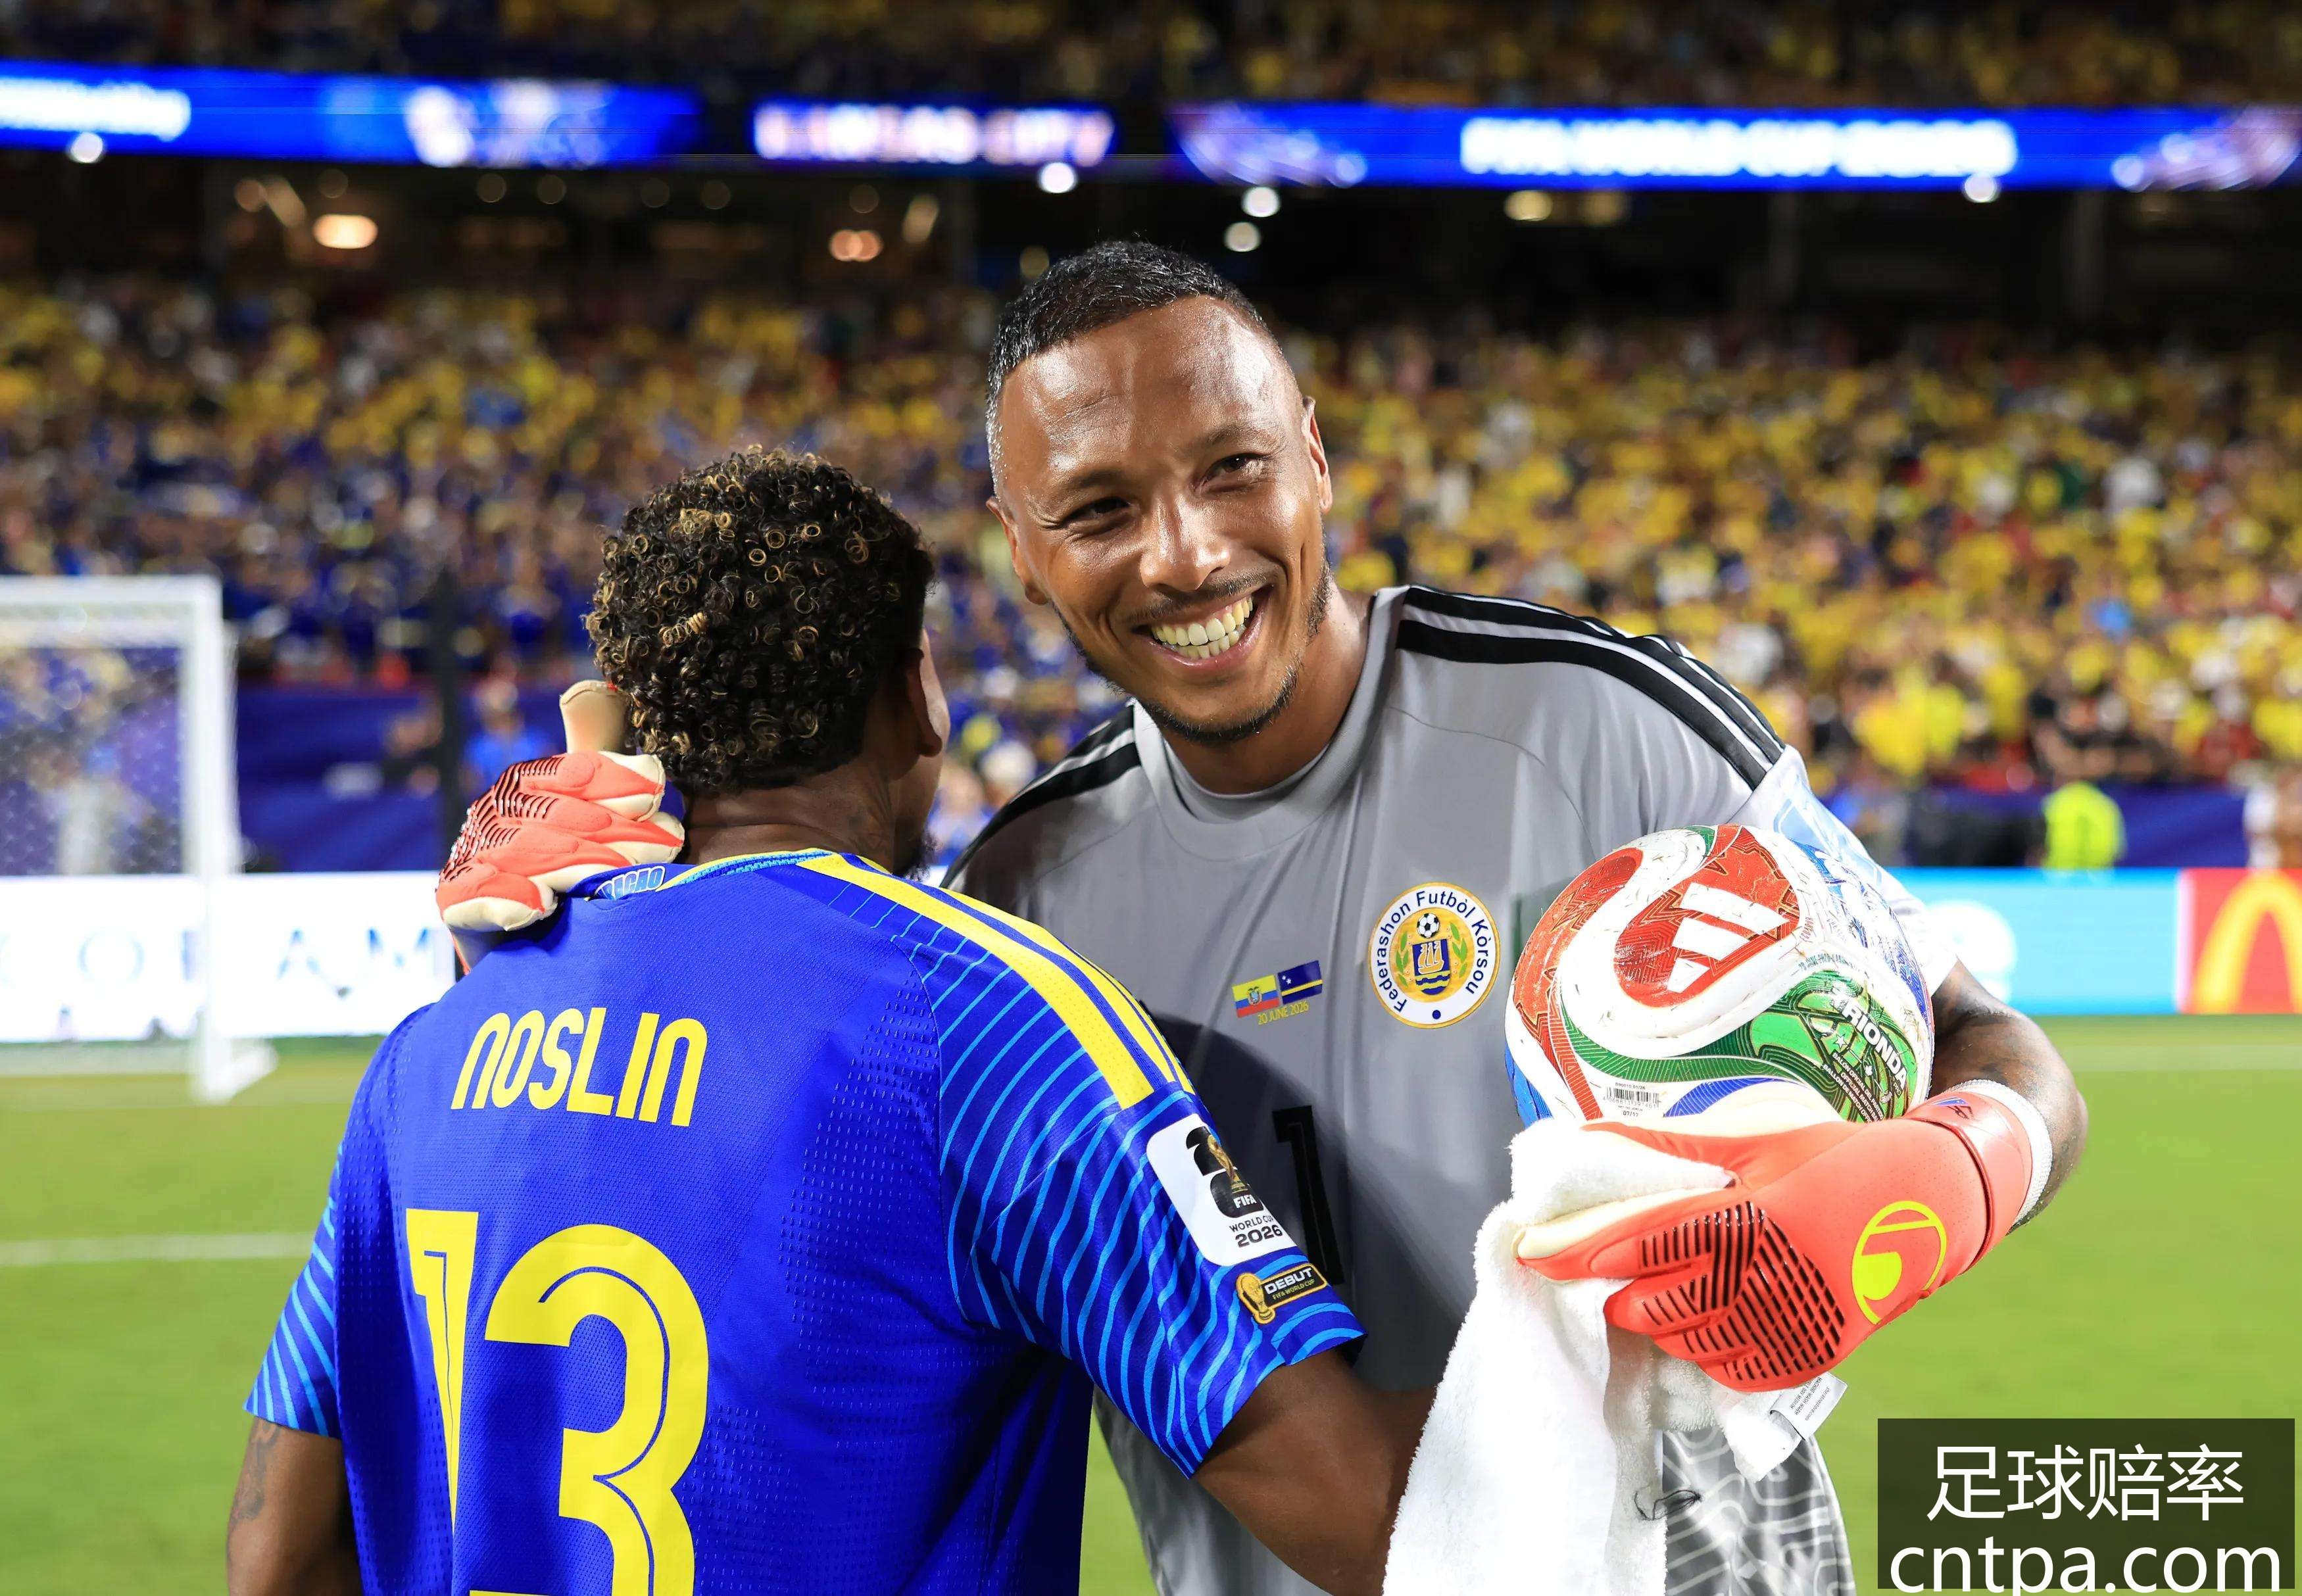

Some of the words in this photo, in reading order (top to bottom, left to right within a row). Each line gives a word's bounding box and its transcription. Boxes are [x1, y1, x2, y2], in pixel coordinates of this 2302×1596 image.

[1377, 902, 1411, 1012] Federashon
[1416, 890, 1475, 918] Futbòl
[1465, 919, 1492, 994] Kòrsou
[1258, 1013, 1268, 1025] 20
[1268, 1005, 1289, 1021] JUNE
[1290, 999, 1309, 1015] 2026
[451, 1007, 708, 1127] NOSLIN
[1823, 1064, 1844, 1087] BALLON
[1848, 1092, 1863, 1111] MATCH
[1832, 1052, 1849, 1073] BALÓN
[1849, 1071, 1866, 1091] OFICIAL
[1864, 1088, 1873, 1101] DEL
[1871, 1098, 1884, 1120] PARTIDO
[1840, 1072, 1861, 1096] OFFICIAL
[1859, 1094, 1874, 1113] MATCH
[1233, 1194, 1257, 1209] FIFA
[1229, 1217, 1262, 1233] WORLD
[1235, 1224, 1283, 1247] 2026
[1264, 1267, 1313, 1295] DEBUT
[1272, 1291, 1286, 1300] FIFA
[1285, 1284, 1305, 1295] WORLD
[1304, 1278, 1315, 1287] CUP
[406, 1208, 708, 1596] 13
